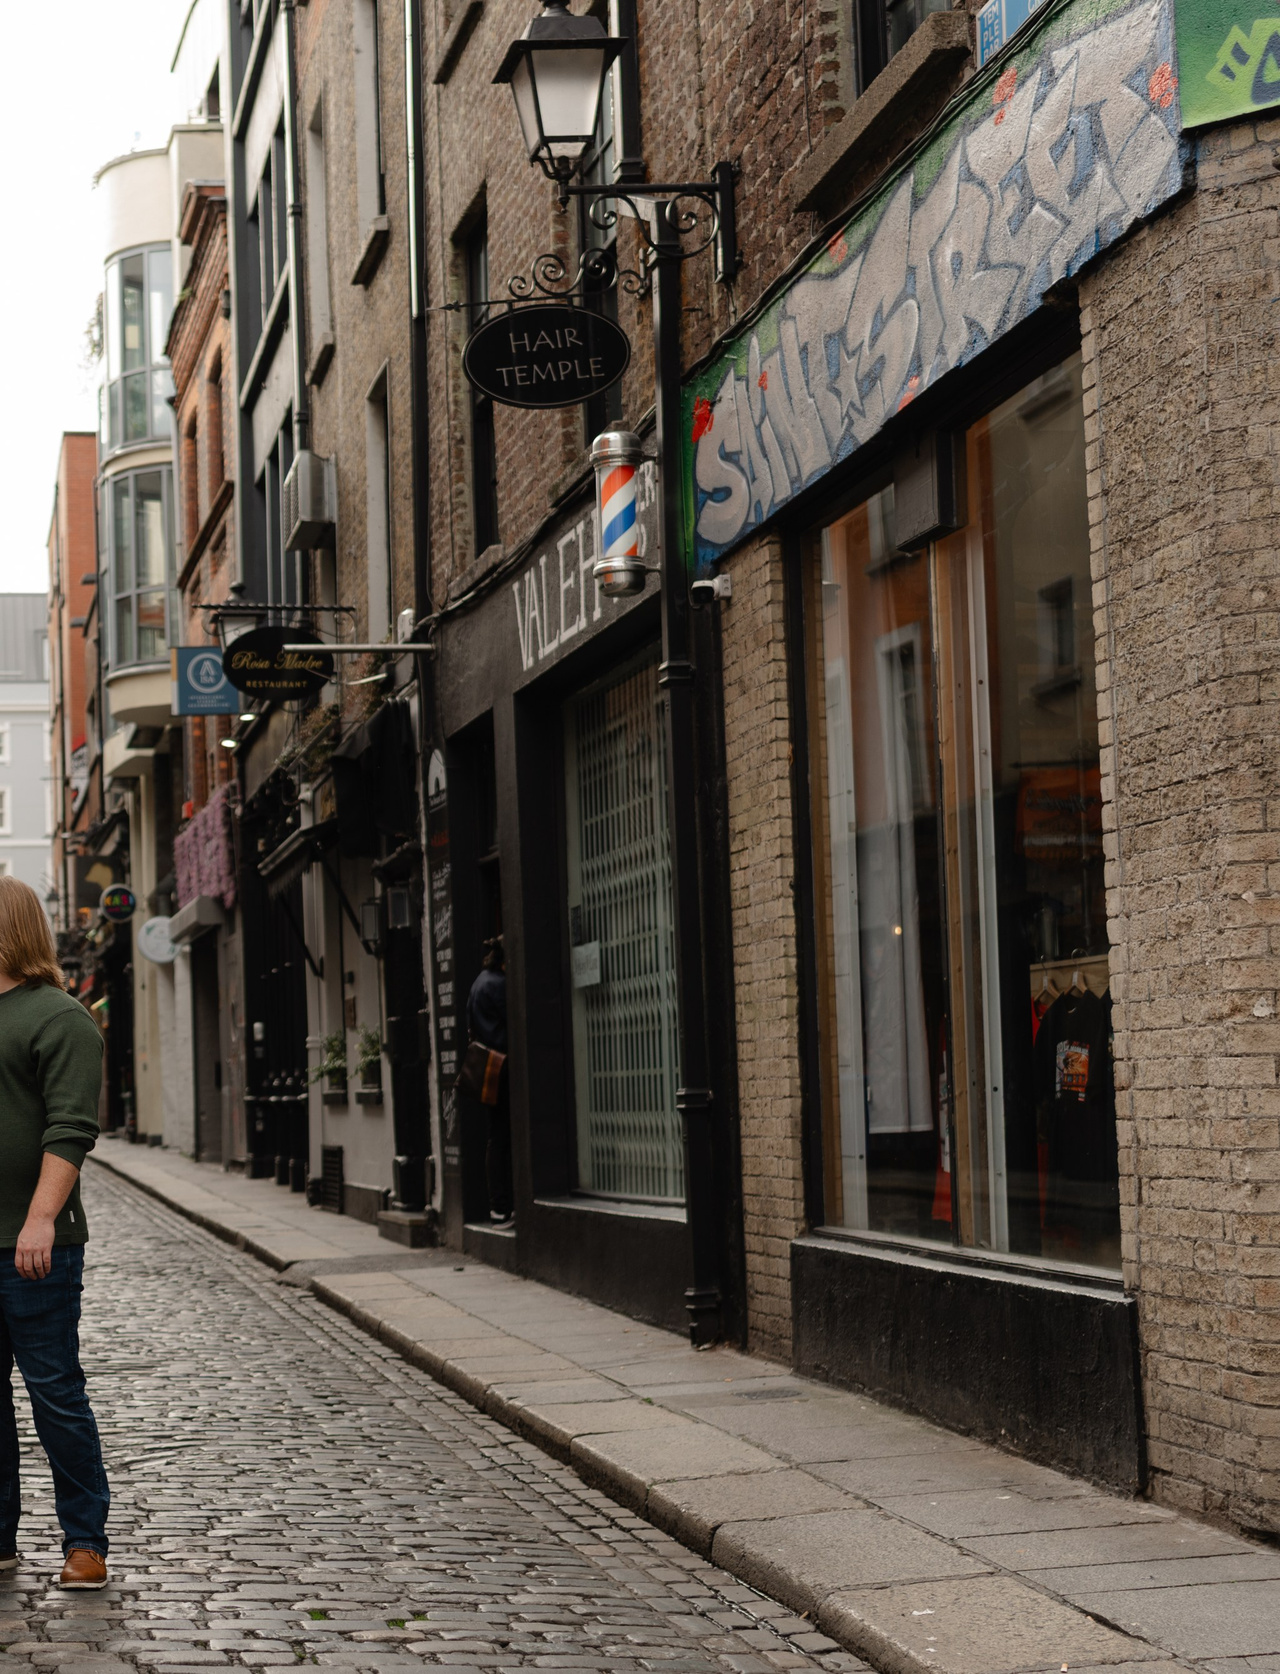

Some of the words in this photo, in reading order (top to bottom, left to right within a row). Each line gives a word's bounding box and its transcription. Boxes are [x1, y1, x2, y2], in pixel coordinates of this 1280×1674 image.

[983, 19, 999, 48] PLE
[509, 327, 583, 353] HAIR
[496, 356, 605, 388] TEMPLE
[231, 651, 270, 670] Rosa
[246, 680, 308, 689] RESTAURANT
